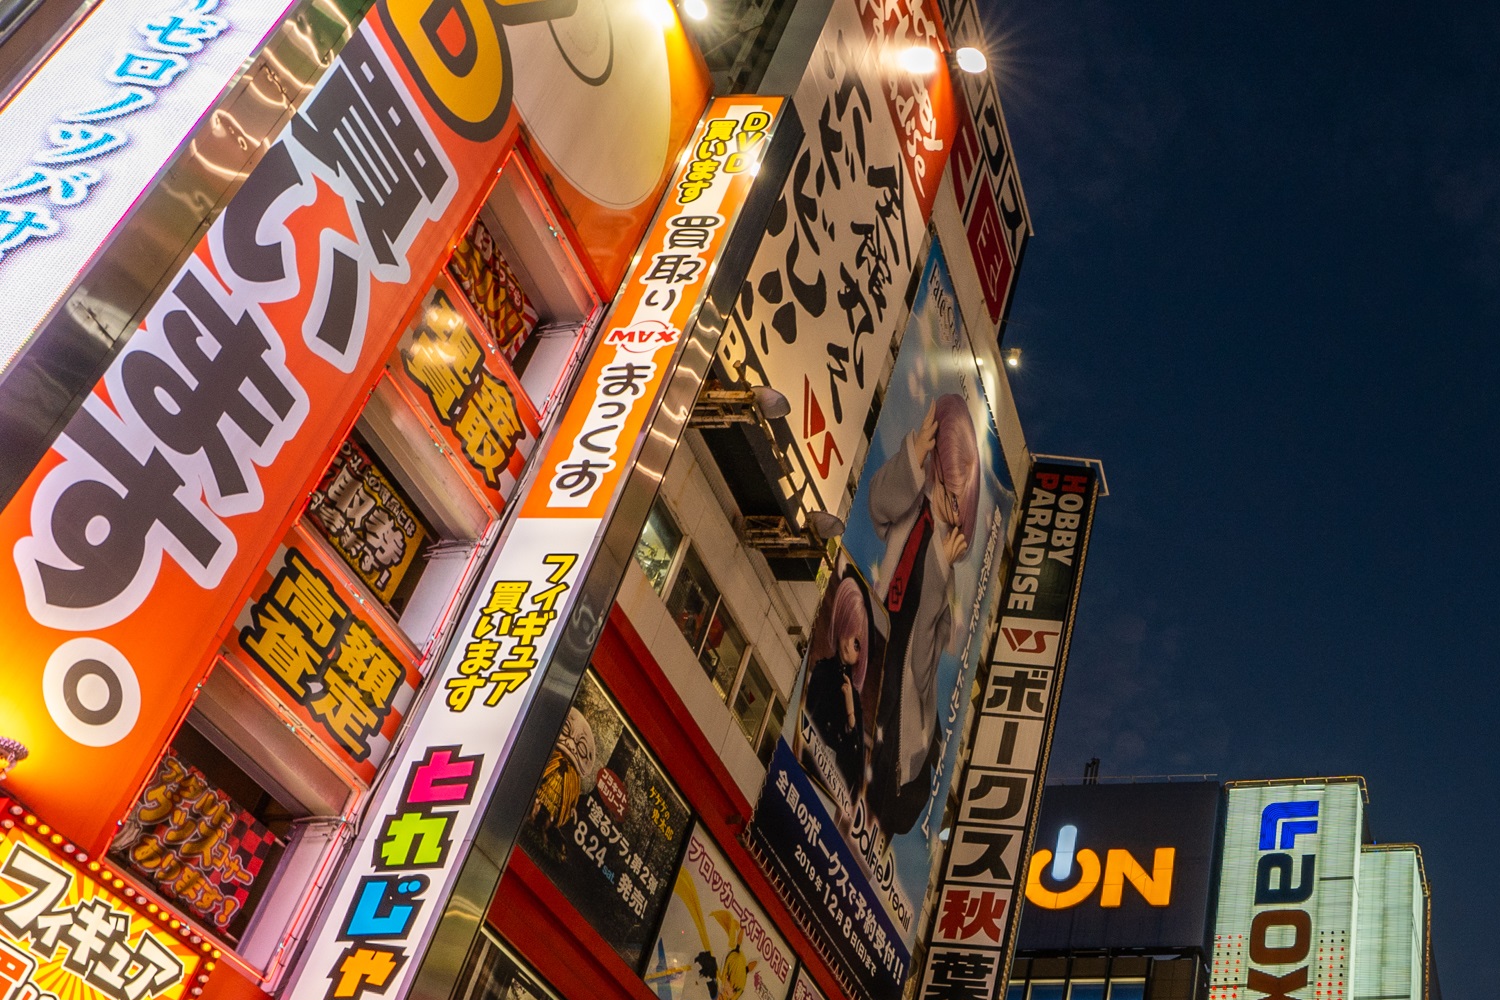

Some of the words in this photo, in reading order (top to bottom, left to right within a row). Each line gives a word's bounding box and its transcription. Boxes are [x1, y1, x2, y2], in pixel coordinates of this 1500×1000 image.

[679, 119, 740, 204] 買います
[723, 111, 771, 174] DVD
[645, 214, 724, 313] 買取り
[1006, 471, 1057, 611] PARADISE
[1051, 475, 1088, 567] HOBBY
[241, 610, 381, 760] 査定
[277, 550, 405, 711] 高額
[445, 581, 531, 712] 買います
[487, 553, 579, 708] フィギュア
[572, 820, 606, 870] 8.24
